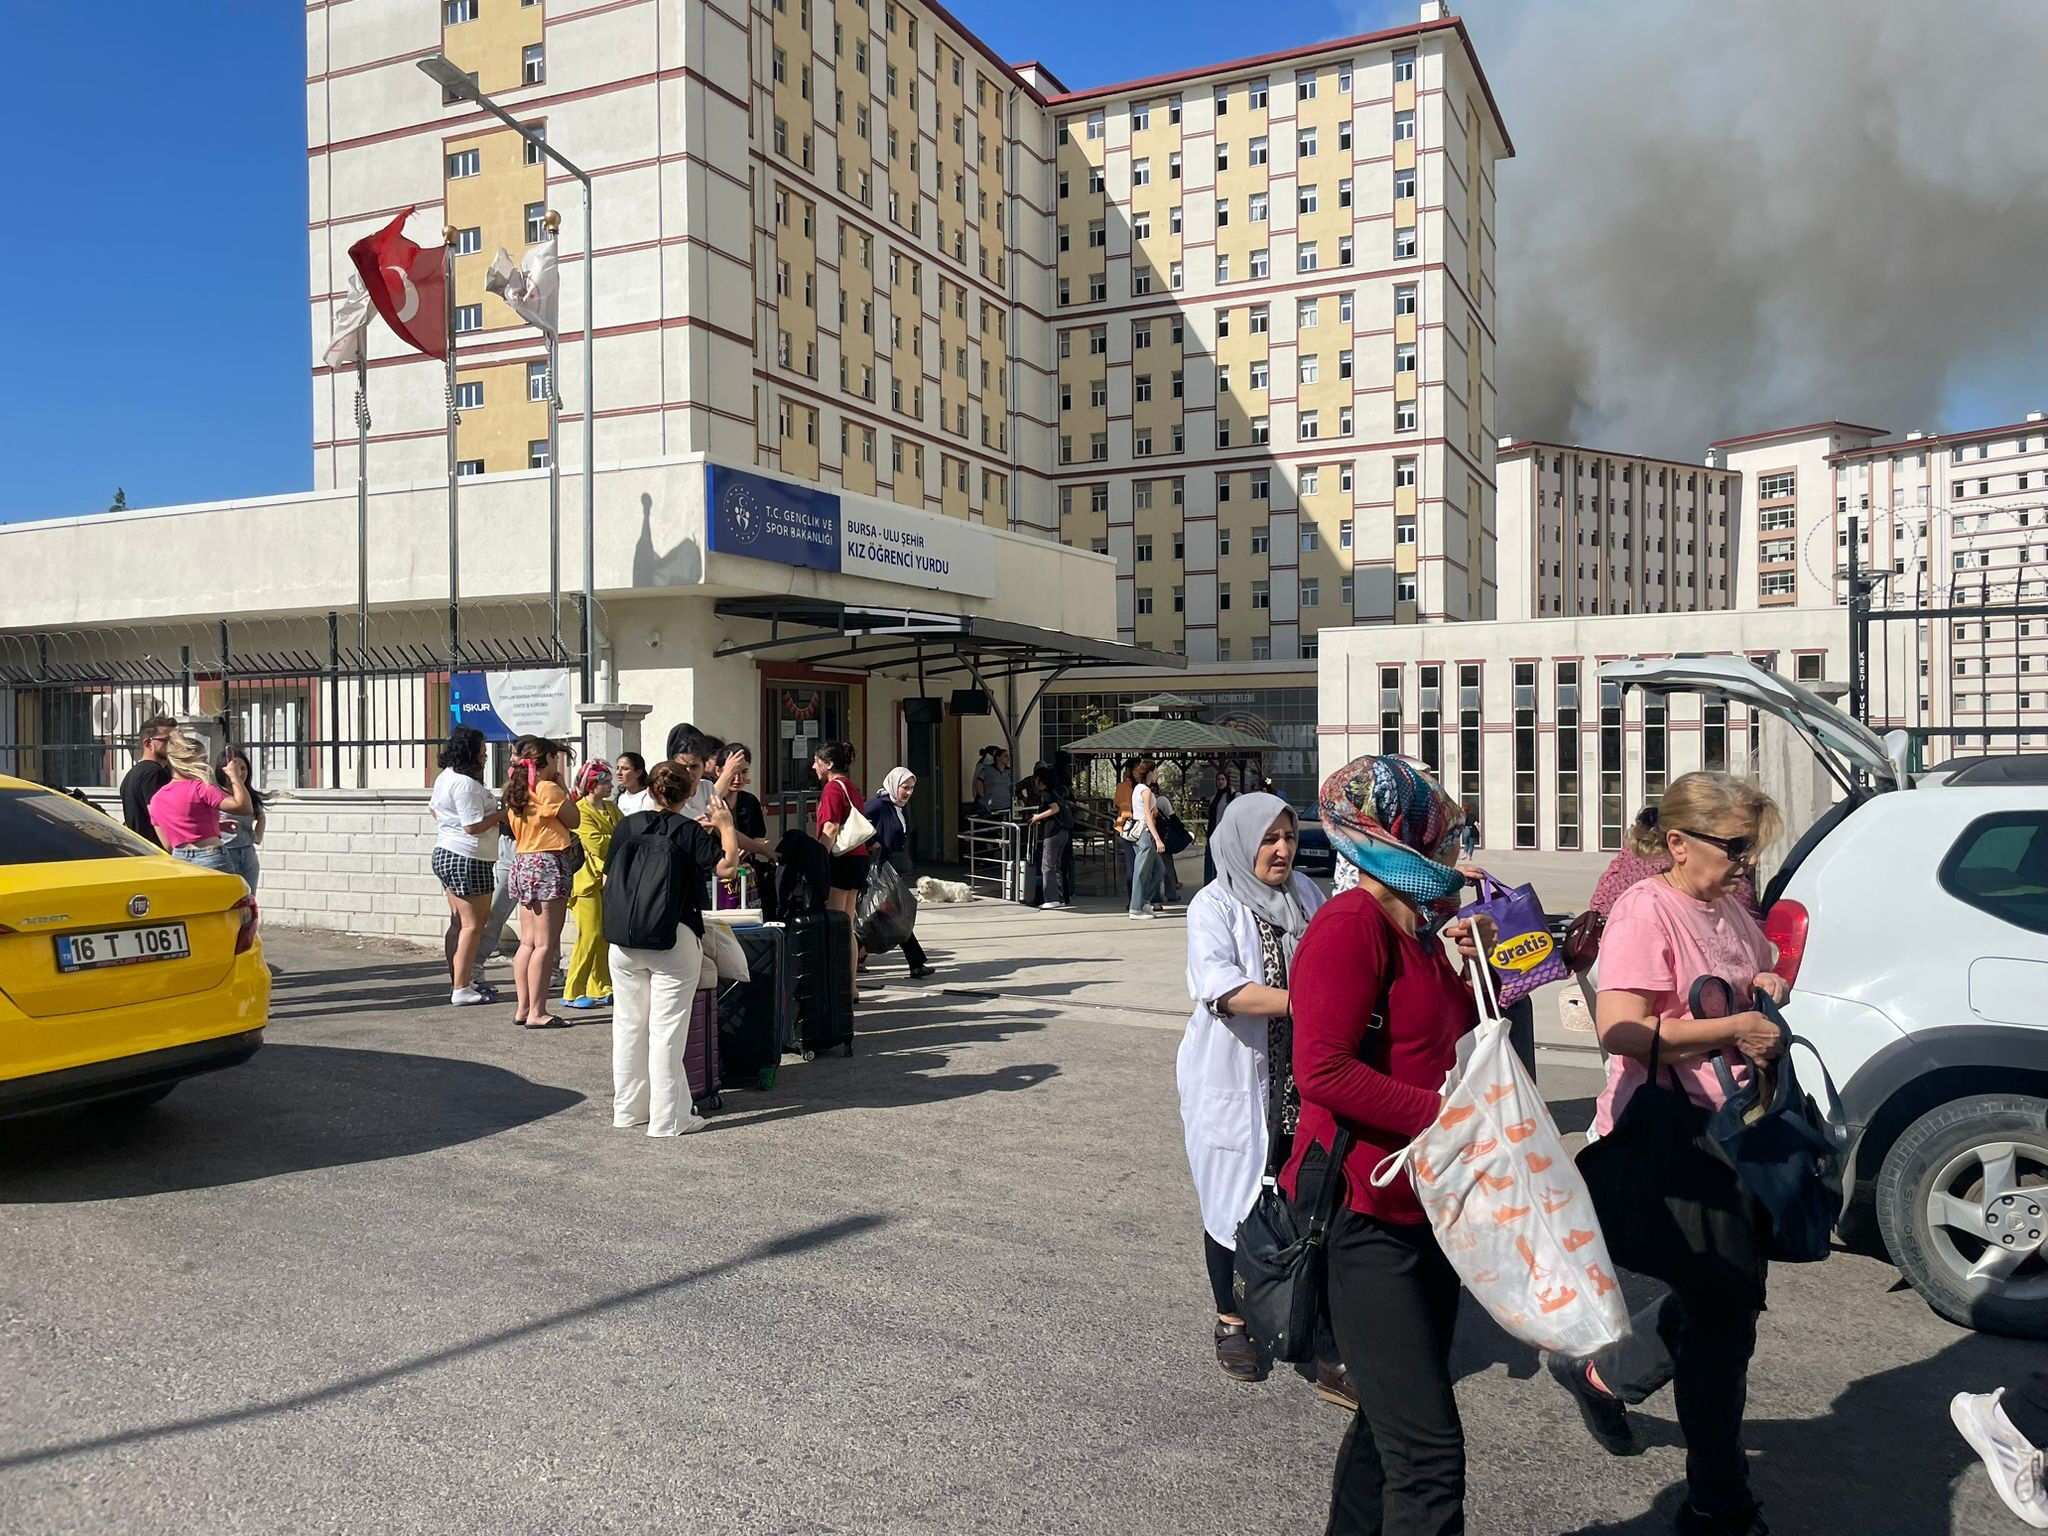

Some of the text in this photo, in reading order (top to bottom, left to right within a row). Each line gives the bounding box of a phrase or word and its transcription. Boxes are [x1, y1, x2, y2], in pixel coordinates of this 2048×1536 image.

[765, 505, 782, 520] T.C.
[822, 519, 833, 531] VE
[766, 522, 833, 546] SPOR BAKANLIĞI
[847, 520, 877, 538] BURSA
[883, 528, 900, 543] ULU
[901, 532, 925, 548] ŞEHİR
[847, 541, 949, 575] KIZ ÖĞRENCİ YURDU
[71, 937, 96, 962] 16
[104, 934, 120, 958] T
[135, 928, 183, 955] 1061
[1496, 935, 1548, 965] gratis
